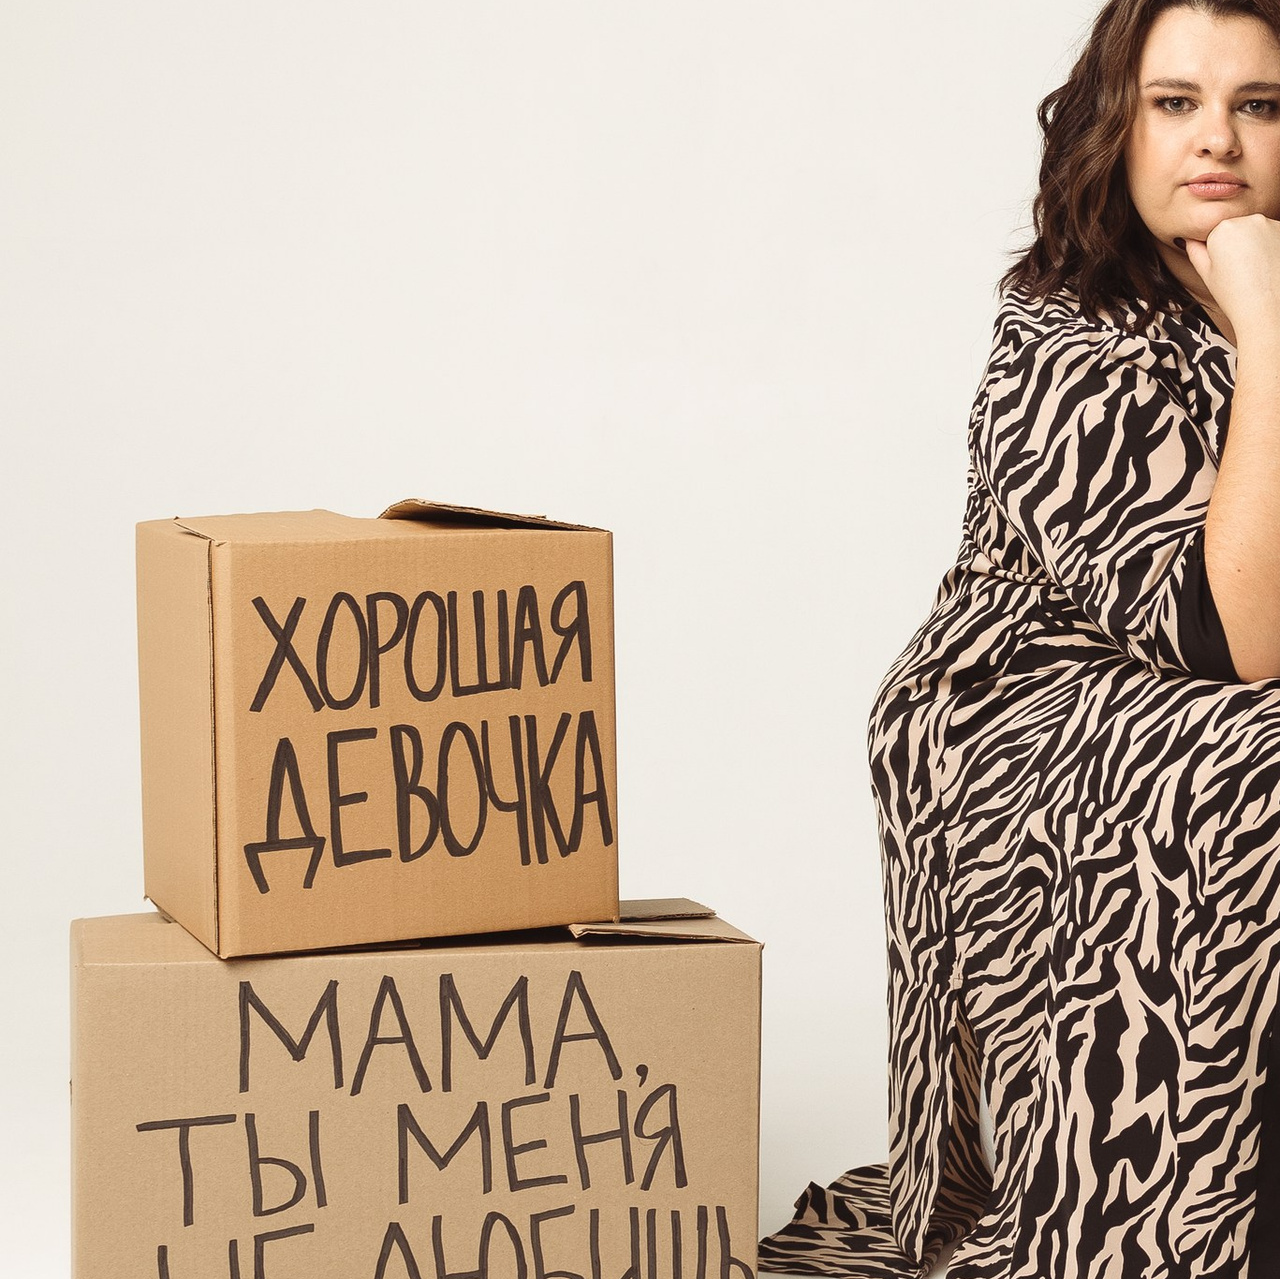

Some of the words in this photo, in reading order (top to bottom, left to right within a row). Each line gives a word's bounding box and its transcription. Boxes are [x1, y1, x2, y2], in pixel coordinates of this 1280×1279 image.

[250, 580, 594, 715] ХОРОШАЯ
[244, 709, 616, 896] ДЕВОЧКА
[239, 971, 650, 1096] МАМА,
[136, 1113, 329, 1227] ТЫ
[397, 1082, 689, 1206] МЕНЯ
